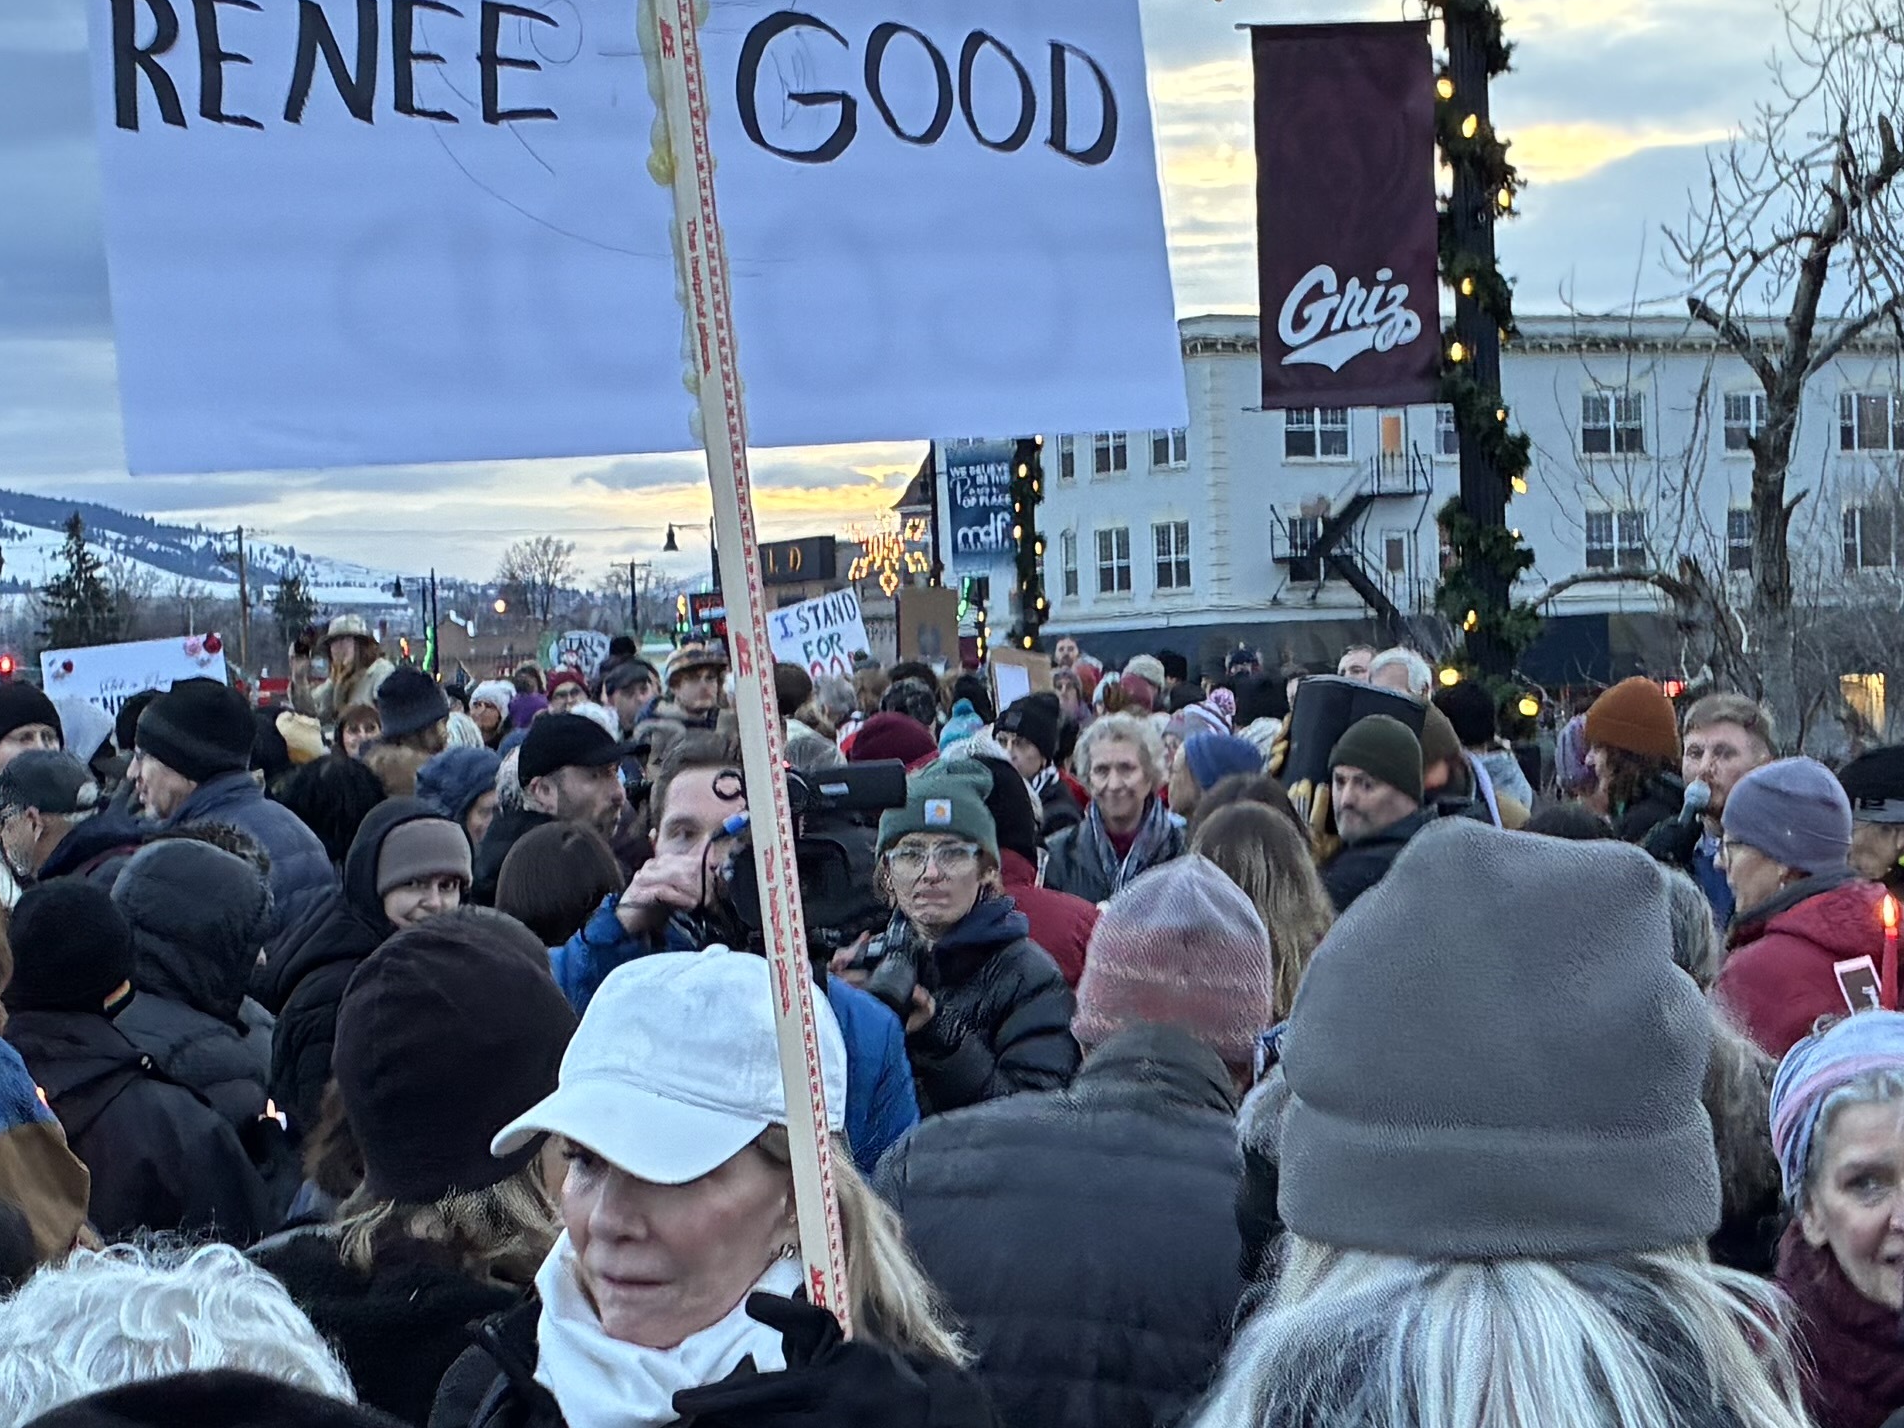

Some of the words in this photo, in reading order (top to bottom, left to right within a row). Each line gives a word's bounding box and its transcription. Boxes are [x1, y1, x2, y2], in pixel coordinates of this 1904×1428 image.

[735, 9, 1118, 165] GOOD
[1277, 262, 1422, 357] Griz
[957, 511, 1011, 551] mdf
[774, 613, 794, 639] I
[796, 590, 858, 634] STAND
[801, 632, 845, 664] FOR
